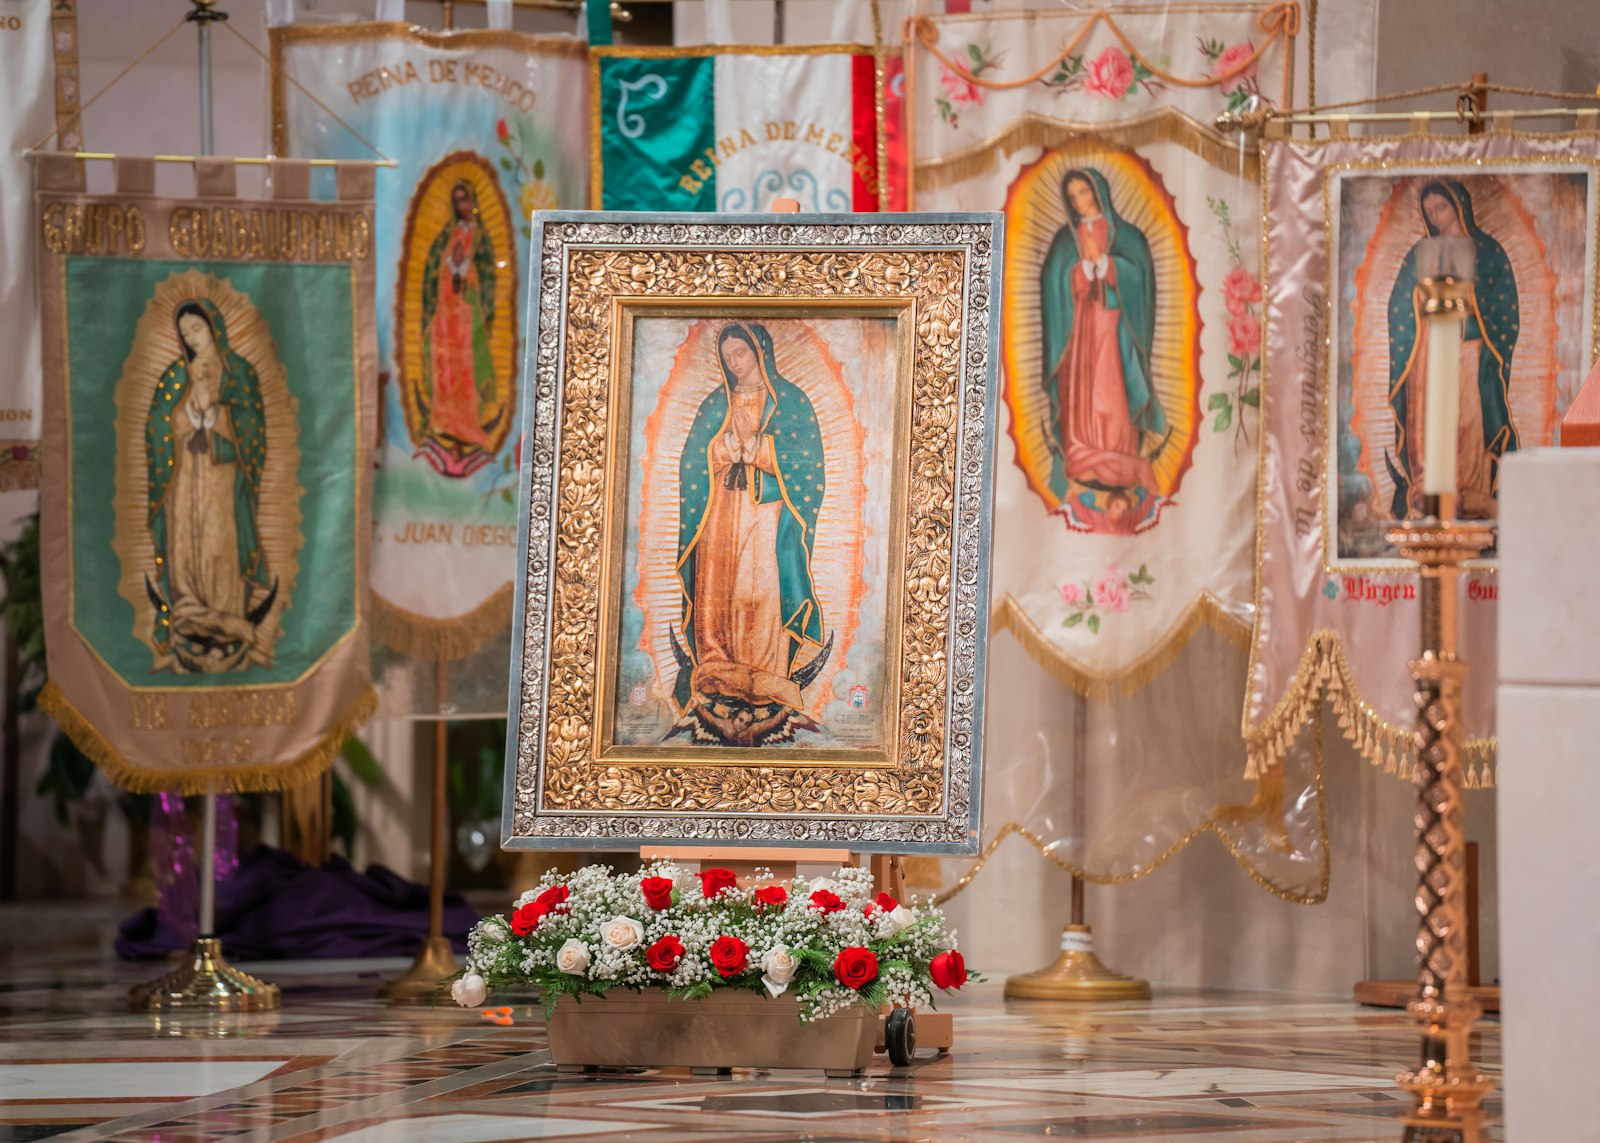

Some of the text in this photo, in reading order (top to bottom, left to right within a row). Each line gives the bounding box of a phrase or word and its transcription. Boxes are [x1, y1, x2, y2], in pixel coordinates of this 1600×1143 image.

[347, 60, 421, 106] REINA
[428, 59, 458, 84] DE
[678, 127, 757, 196] REINA
[763, 120, 796, 142] DE
[42, 201, 371, 261] GRUPO GUADALUPANO
[1296, 457, 1319, 493] de
[394, 520, 454, 546] JUAN
[1342, 575, 1416, 606] Virgen
